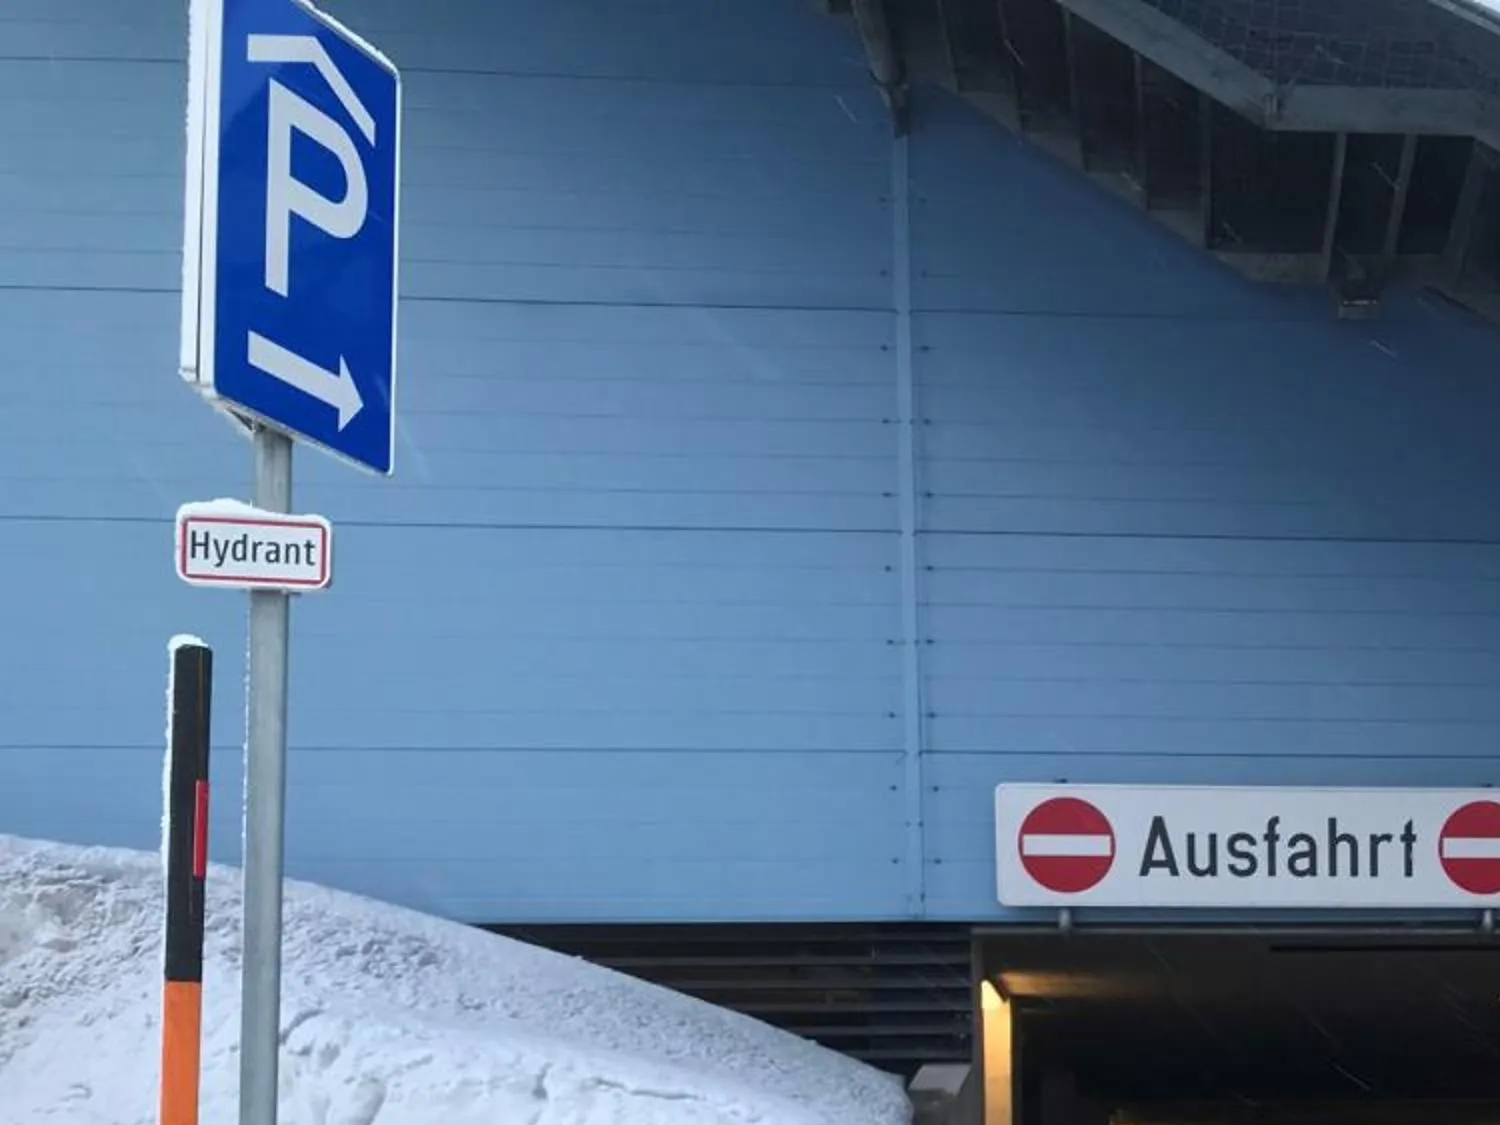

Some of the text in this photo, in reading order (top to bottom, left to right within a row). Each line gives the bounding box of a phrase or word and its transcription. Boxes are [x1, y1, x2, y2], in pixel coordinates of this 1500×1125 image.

[265, 78, 368, 298] P
[190, 530, 316, 567] Hydrant
[1139, 816, 1417, 877] Ausfahrt
